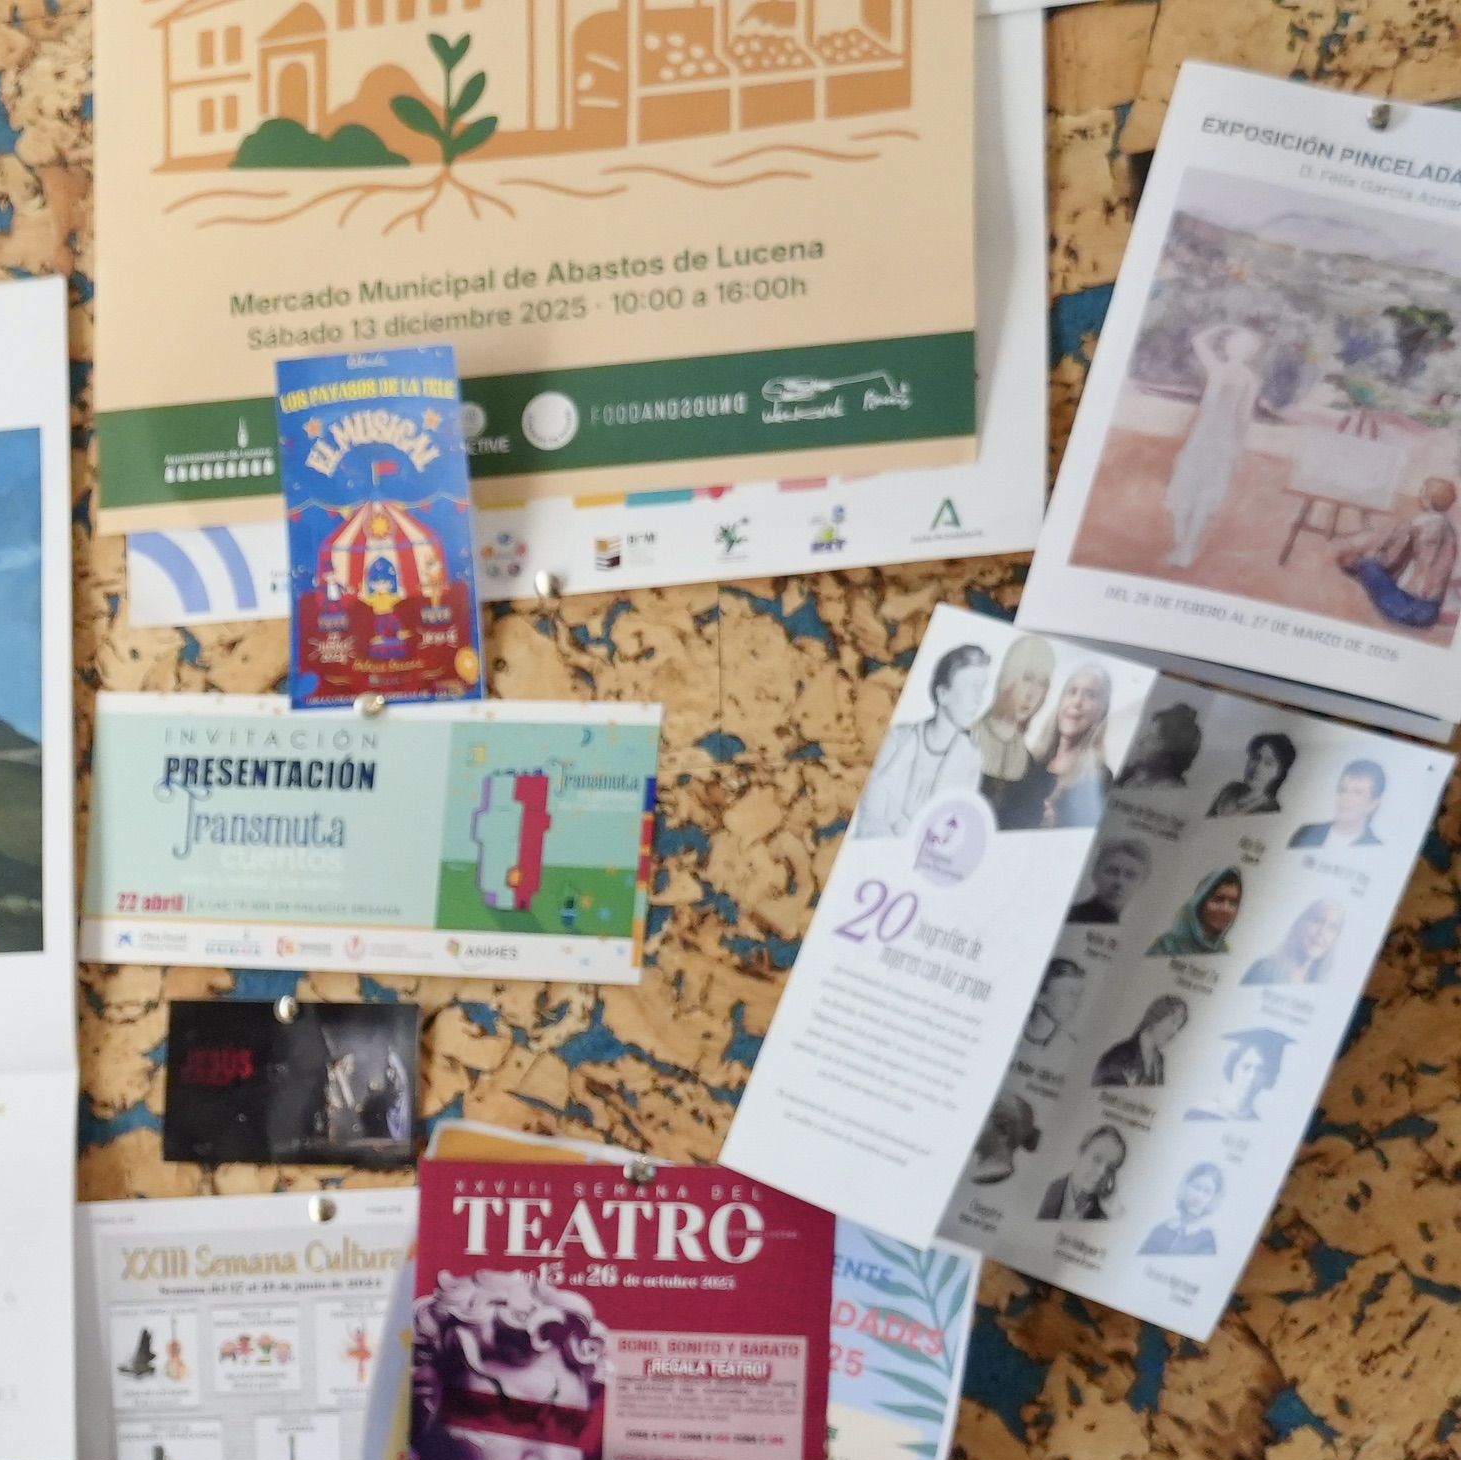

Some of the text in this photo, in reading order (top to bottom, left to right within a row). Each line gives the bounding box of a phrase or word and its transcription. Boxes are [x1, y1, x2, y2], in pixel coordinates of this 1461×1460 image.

[1201, 112, 1335, 160] EXPOSICIÓN
[230, 240, 825, 316] Mercado Municipal de Abastos de Lucena
[247, 275, 808, 350] Sábado 13 diciembre 2025 10:00 a 16:00h
[163, 726, 377, 750] INVITACIÓN
[164, 752, 377, 792] PRESENTACIÓN
[152, 780, 347, 860] Transmuta
[833, 877, 920, 947] 20
[573, 1181, 689, 1200] SEMANA
[710, 1184, 763, 1201] DEL
[452, 1195, 766, 1264] TEATRO
[193, 1242, 298, 1279] Semana
[586, 1263, 619, 1288] 26
[832, 1298, 946, 1356] DADES
